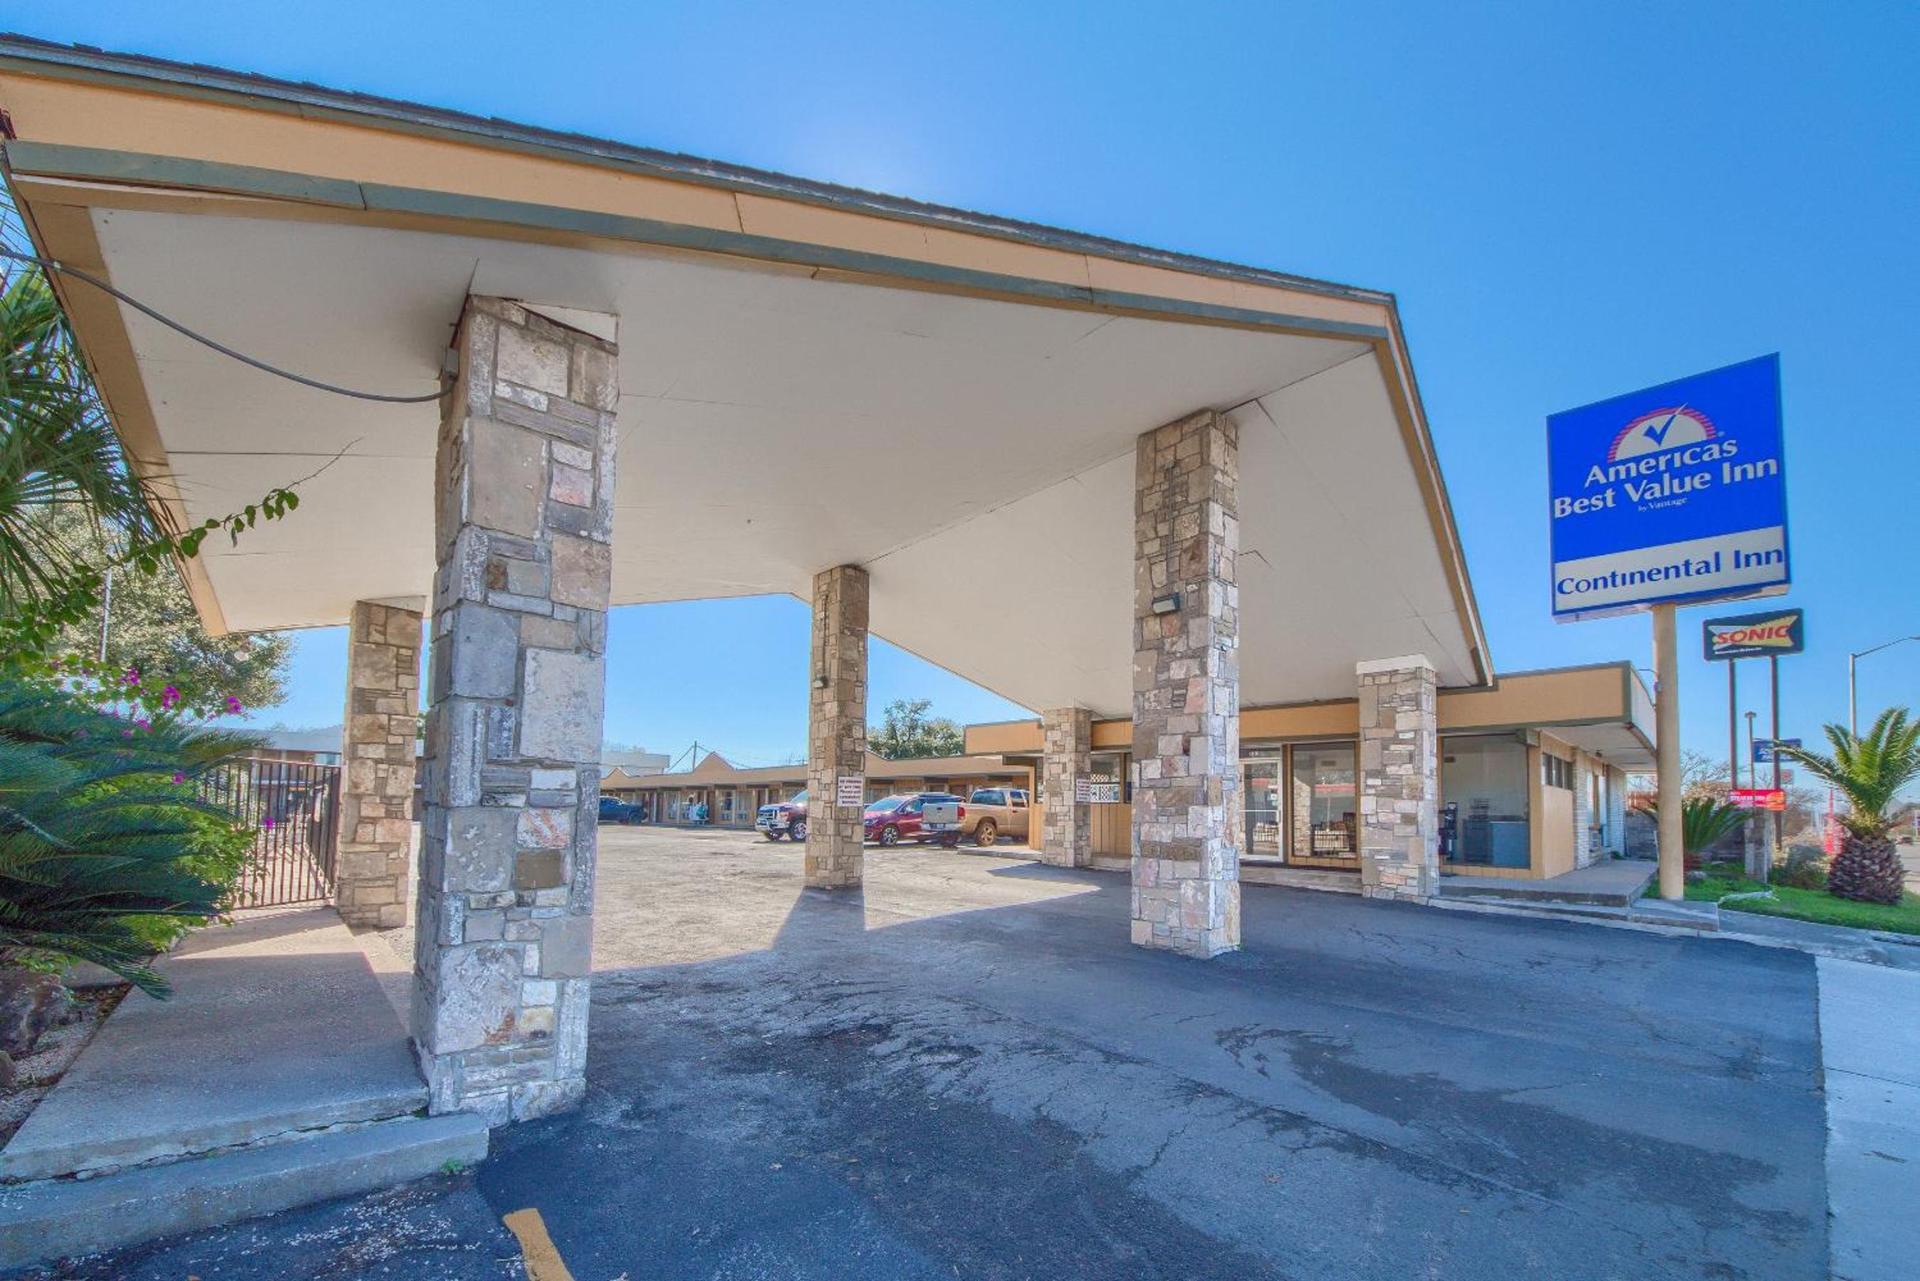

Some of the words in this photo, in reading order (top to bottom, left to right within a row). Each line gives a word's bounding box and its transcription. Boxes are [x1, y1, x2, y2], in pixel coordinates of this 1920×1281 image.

[1554, 489, 1616, 518] Best
[1624, 471, 1712, 503] Value
[1722, 457, 1778, 484] Inn
[1584, 438, 1738, 488] Americas
[1557, 551, 1721, 595] Continental
[1734, 547, 1784, 570] Inn
[1715, 624, 1790, 644] SONIC
